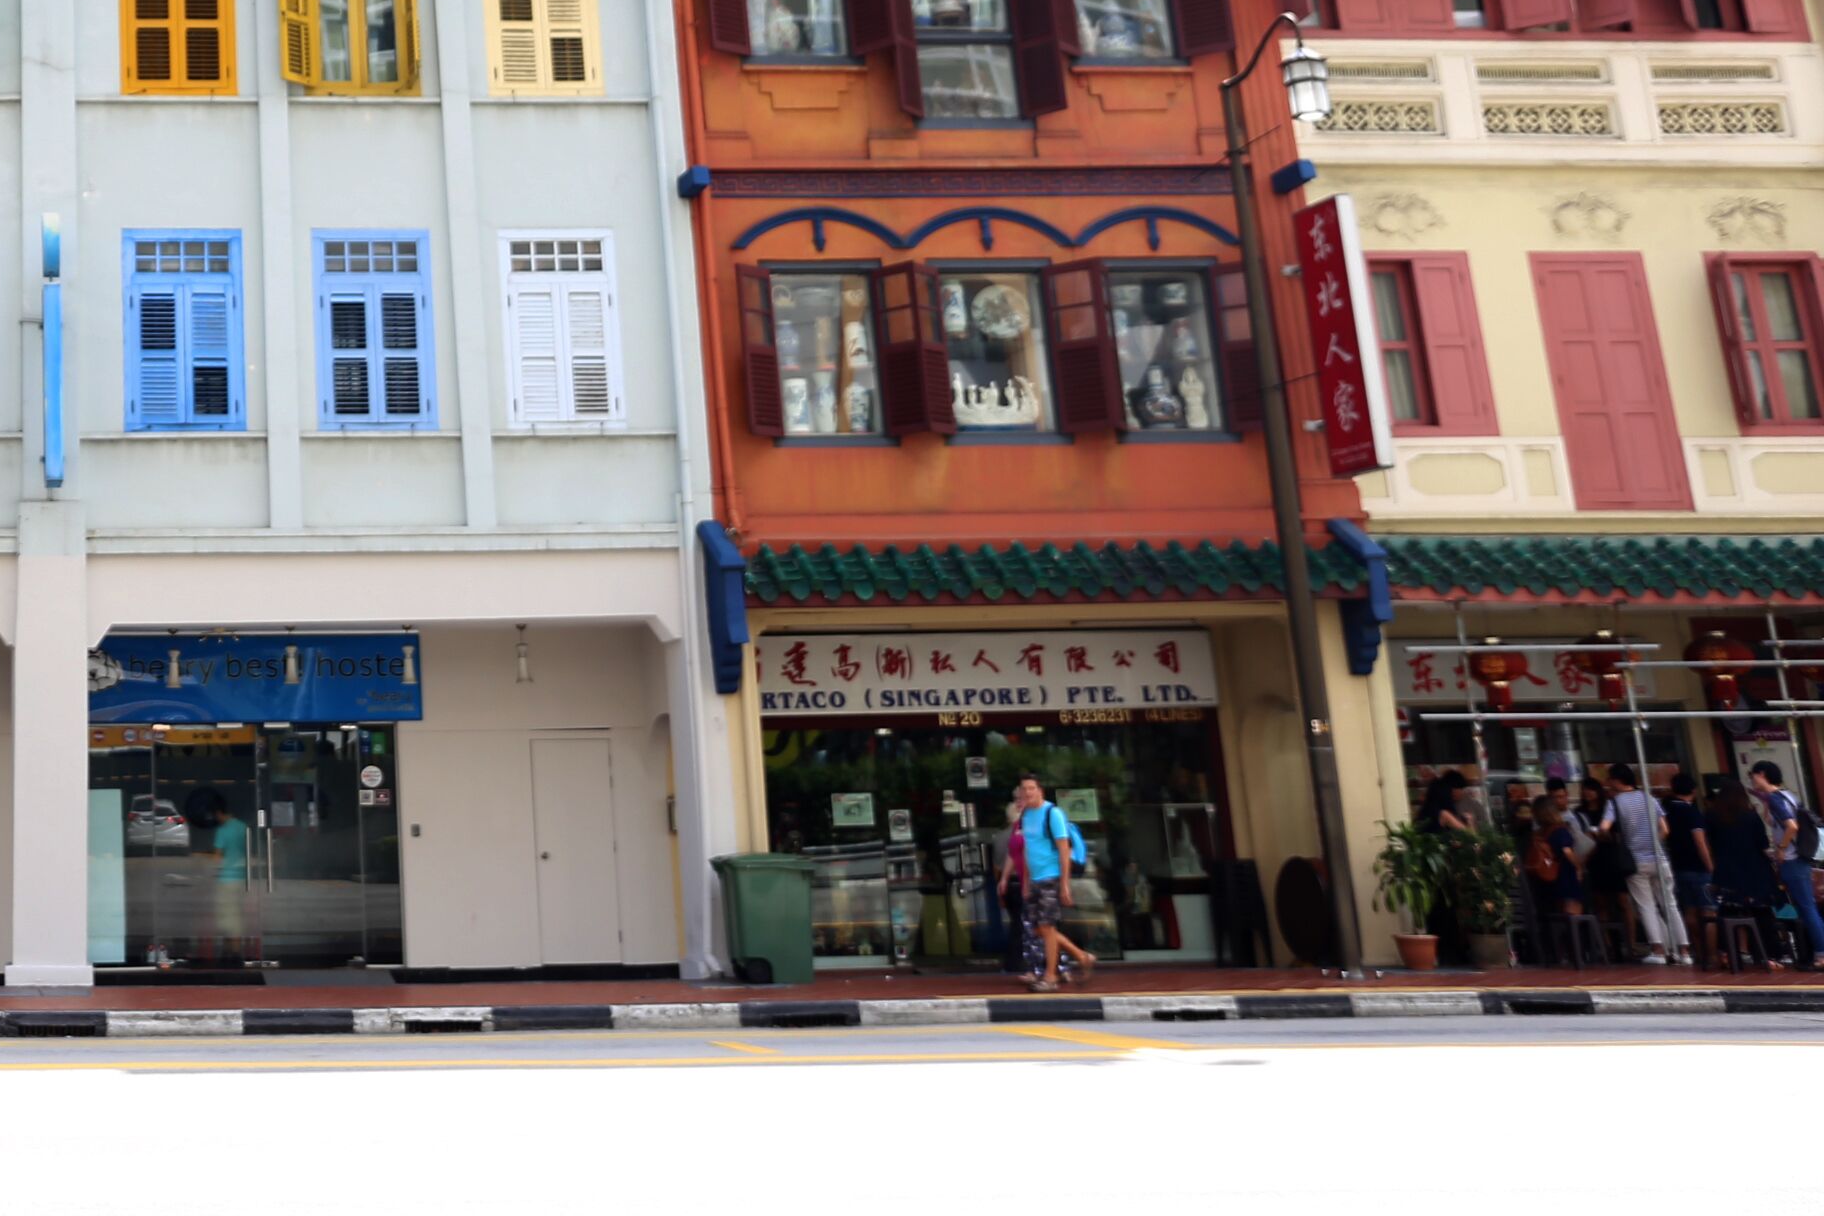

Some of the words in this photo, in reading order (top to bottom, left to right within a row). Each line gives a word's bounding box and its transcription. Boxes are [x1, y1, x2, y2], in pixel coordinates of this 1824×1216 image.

[1308, 213, 1361, 432] 东北人家
[129, 653, 216, 684] bery
[226, 651, 303, 678] bes!
[317, 652, 414, 677] hoste
[755, 641, 1181, 687] 達高(新)私人有限公司
[1066, 685, 1124, 704] PTE.
[1142, 684, 1198, 702] LTD.
